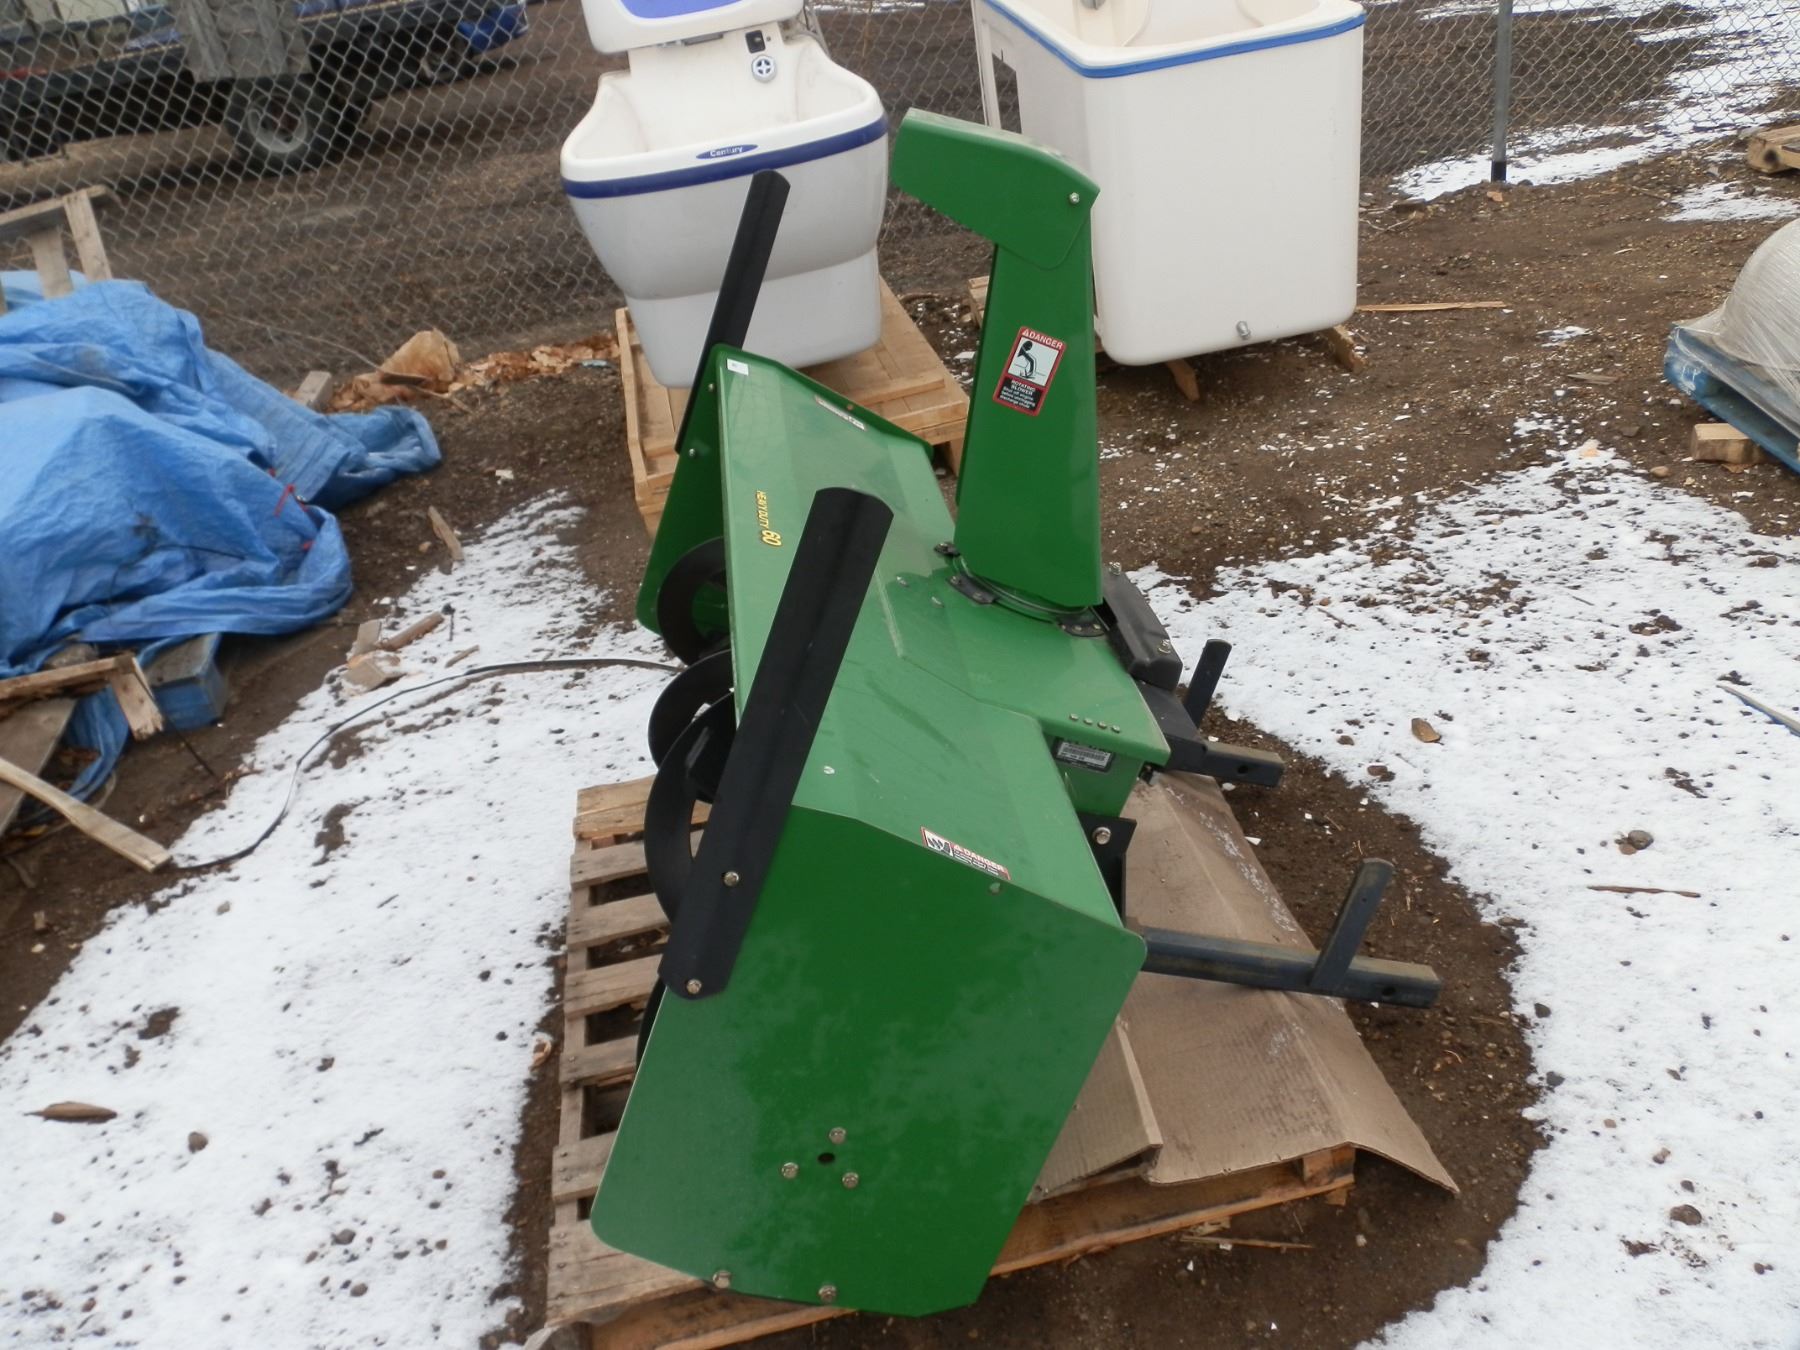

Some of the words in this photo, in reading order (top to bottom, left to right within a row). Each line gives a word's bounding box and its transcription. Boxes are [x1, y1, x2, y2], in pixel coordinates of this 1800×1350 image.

[710, 146, 743, 156] Century
[1029, 330, 1063, 350] DANGER
[757, 490, 767, 510] HEAVY
[758, 510, 769, 529] DUTY
[762, 530, 782, 546] 60
[964, 848, 1004, 872] DANGER
